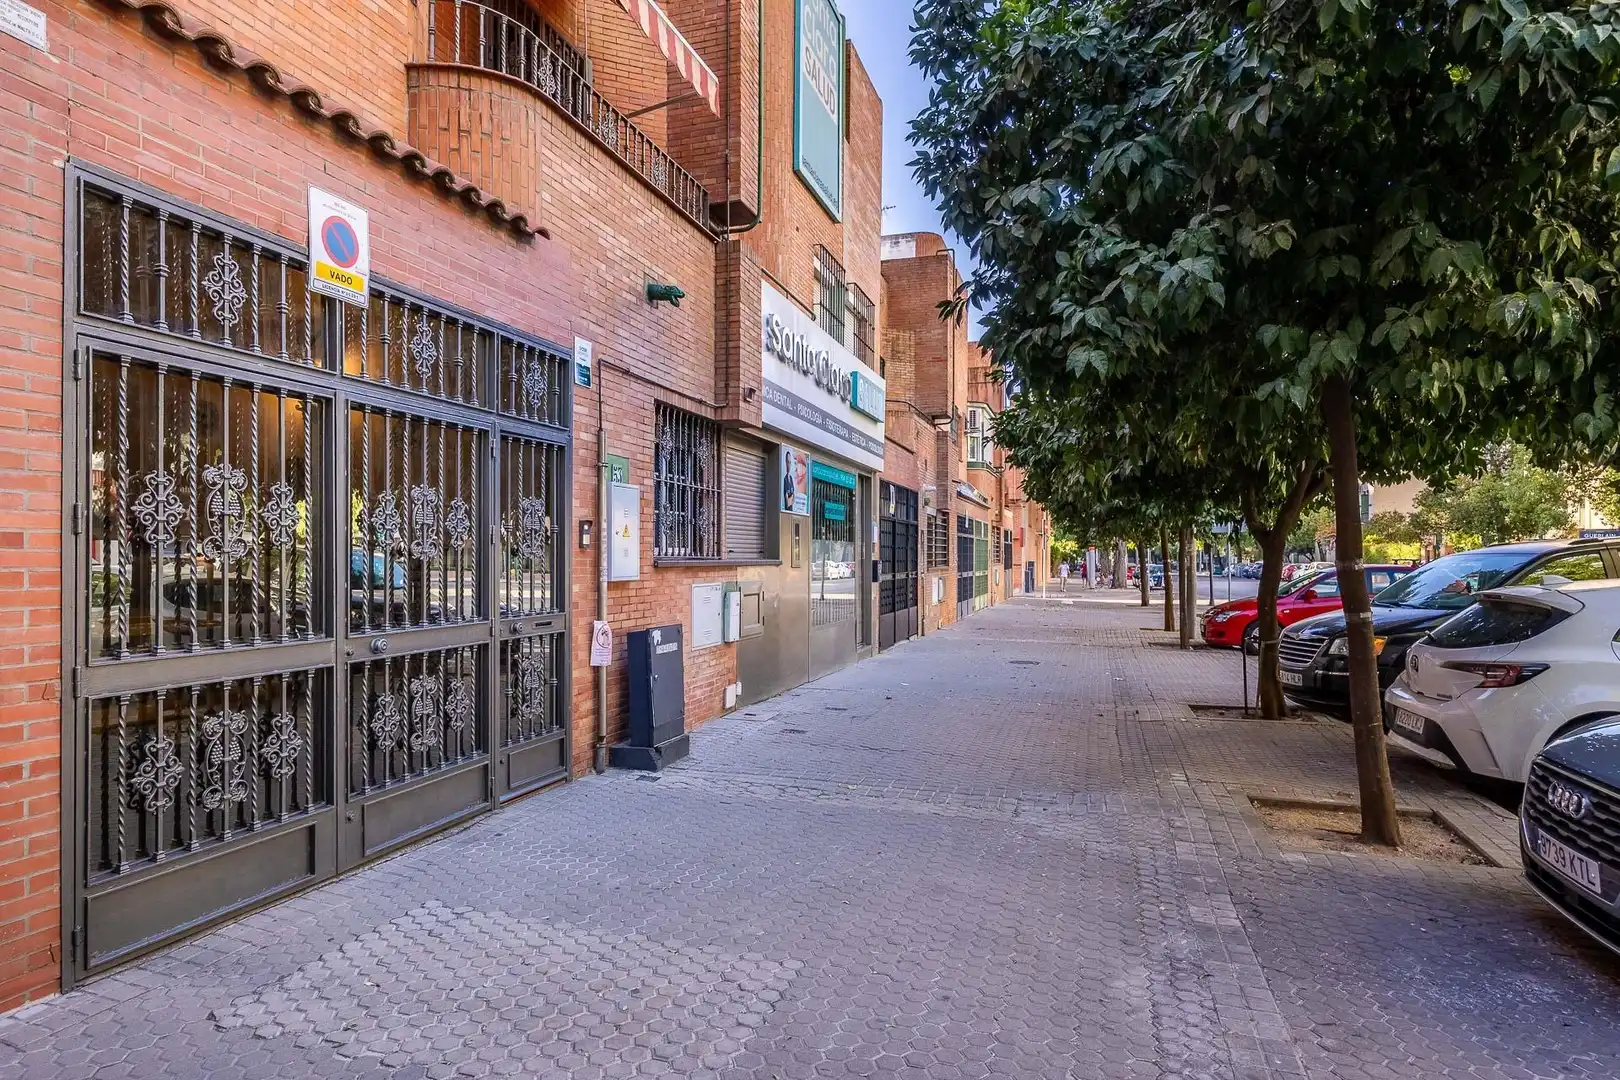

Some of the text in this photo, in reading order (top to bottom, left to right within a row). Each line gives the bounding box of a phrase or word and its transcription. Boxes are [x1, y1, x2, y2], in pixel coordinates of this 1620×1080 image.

[804, 4, 836, 86] Clara
[804, 46, 836, 116] SALUD
[329, 269, 353, 286] VADO
[768, 313, 817, 375] Santa
[773, 389, 793, 411] DENTAL
[797, 403, 823, 425] PSICOLOGÍA
[826, 418, 849, 439] FISIOTERAPIA
[851, 431, 867, 448] ESTÉTICA
[1291, 673, 1302, 685] HLR
[1540, 834, 1596, 887] 9739 KTL
